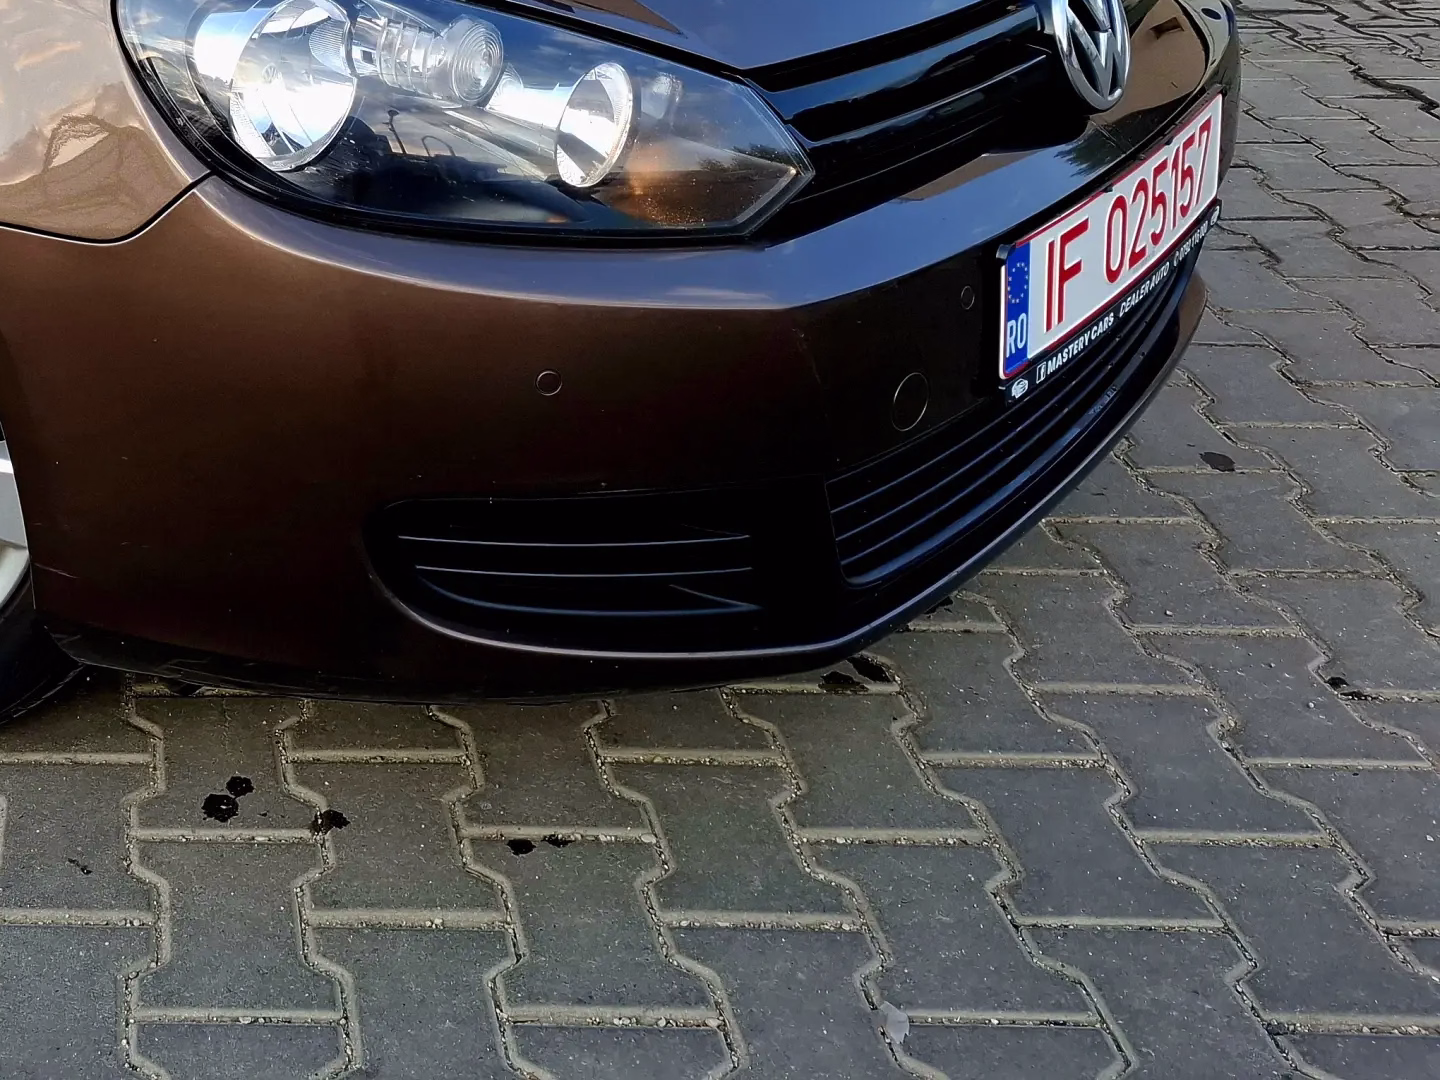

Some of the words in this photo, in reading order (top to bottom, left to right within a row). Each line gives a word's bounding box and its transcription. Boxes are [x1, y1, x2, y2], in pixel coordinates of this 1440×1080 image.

[1044, 217, 1090, 333] IF
[1103, 114, 1213, 284] 025157
[1005, 311, 1028, 358] RO
[1047, 333, 1091, 376] MASTERY
[1090, 311, 1115, 340] CARS
[1119, 281, 1150, 318] DEALER
[1148, 261, 1170, 291] AUTO
